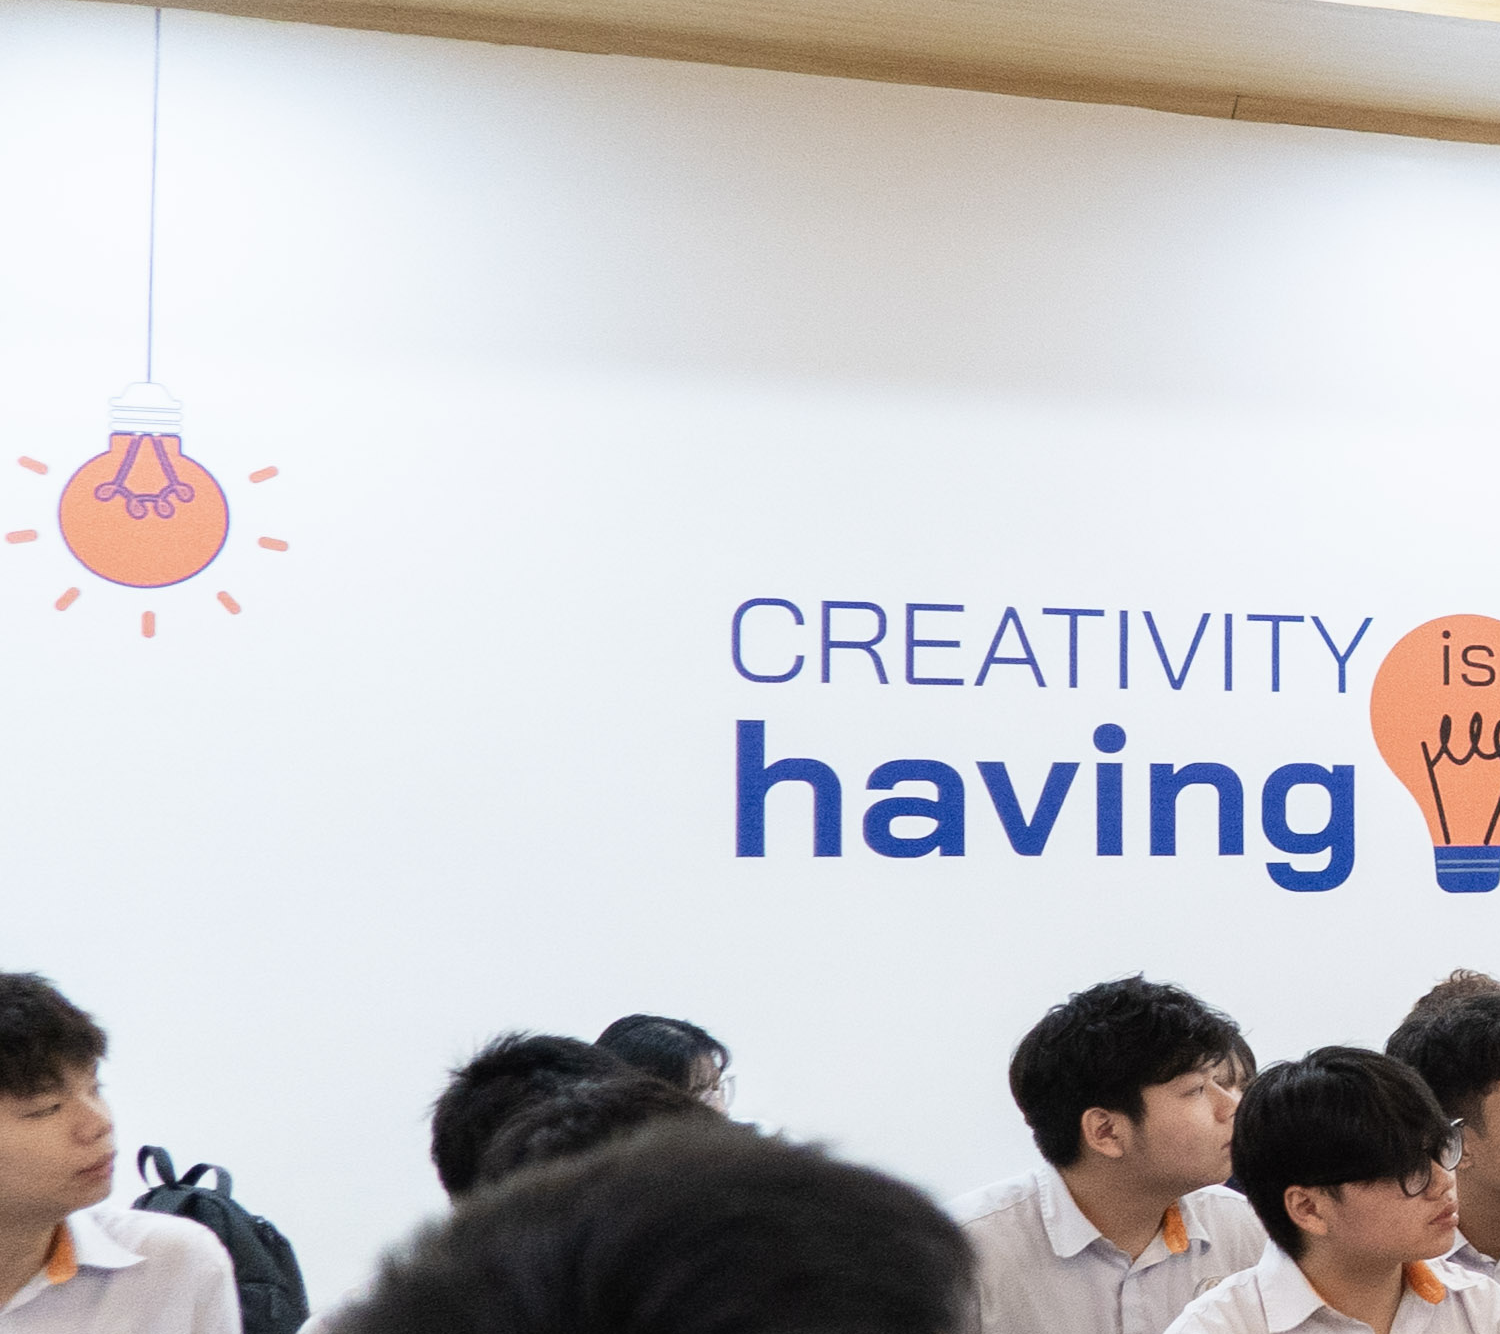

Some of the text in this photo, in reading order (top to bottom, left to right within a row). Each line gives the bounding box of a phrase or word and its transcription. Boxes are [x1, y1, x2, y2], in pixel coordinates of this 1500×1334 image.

[731, 597, 1374, 694] CREATIVITY
[1442, 630, 1496, 687] is
[735, 719, 1356, 893] having
